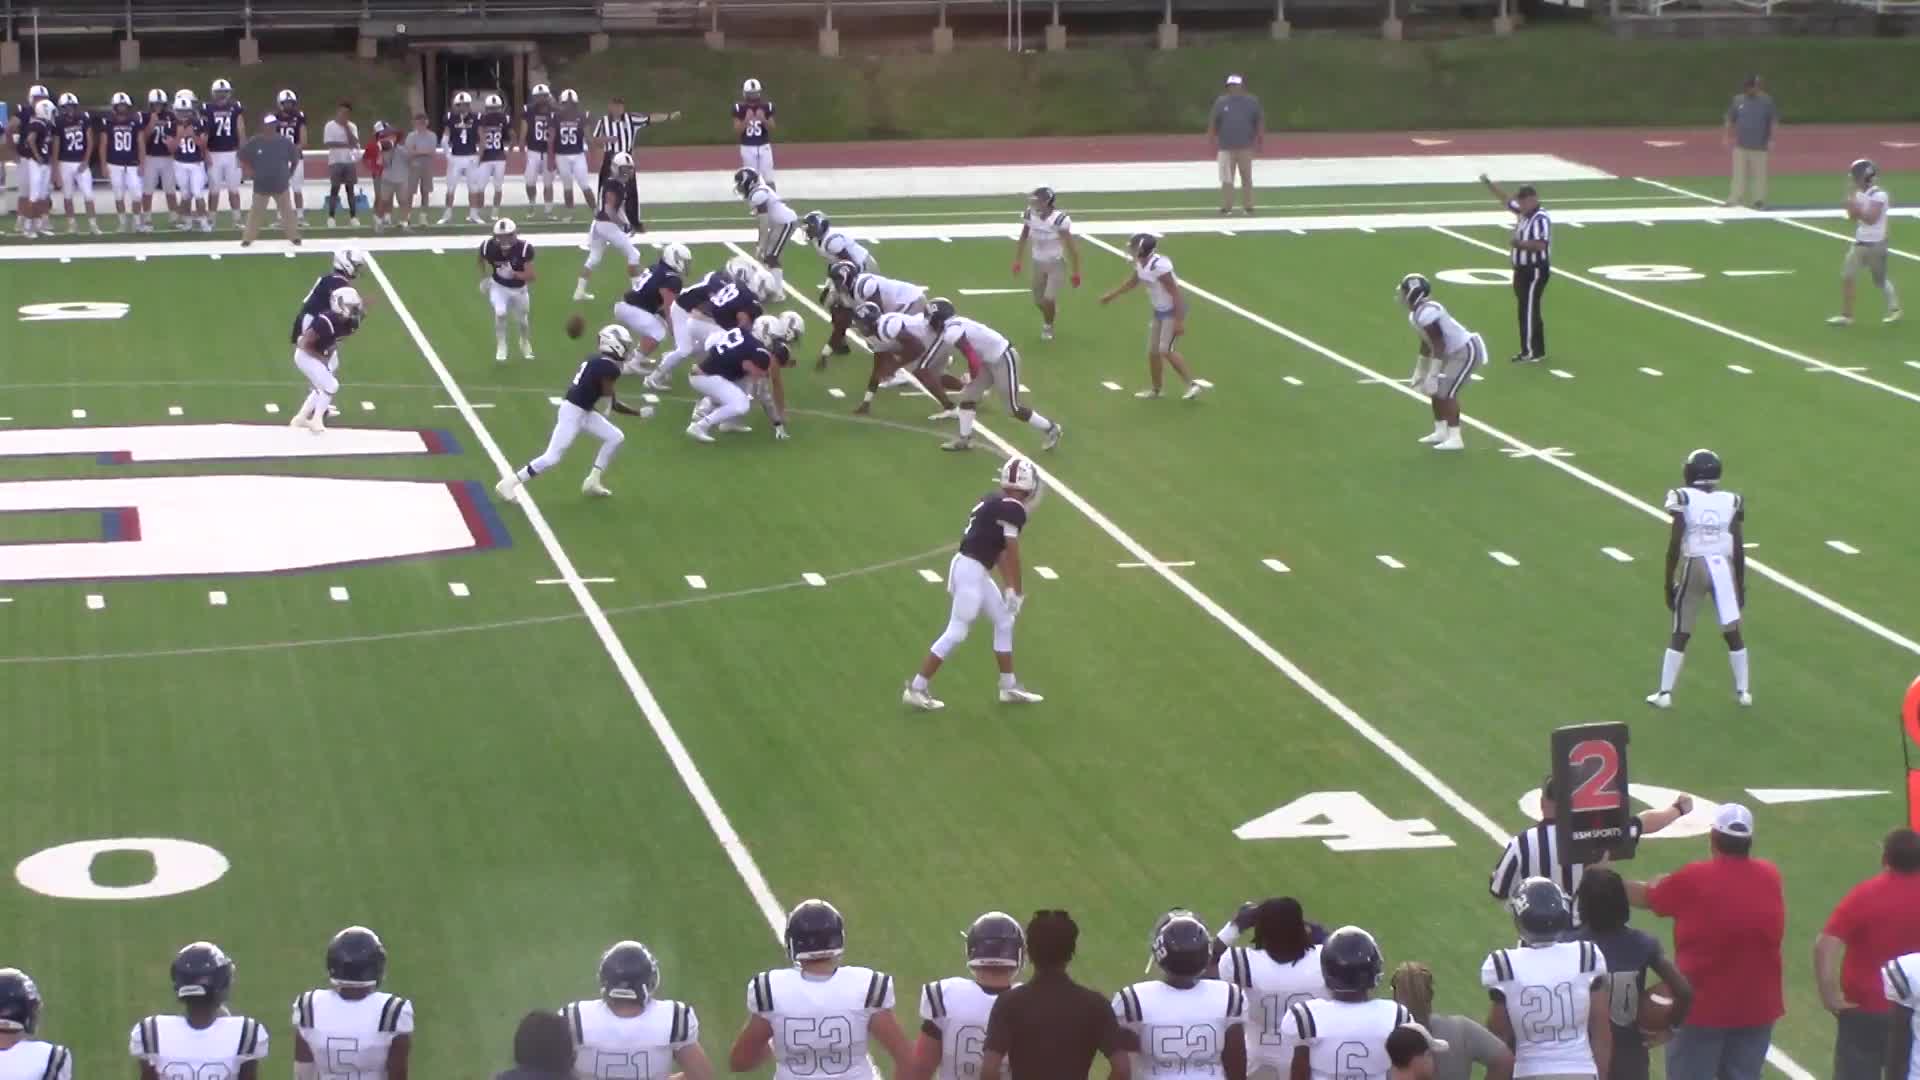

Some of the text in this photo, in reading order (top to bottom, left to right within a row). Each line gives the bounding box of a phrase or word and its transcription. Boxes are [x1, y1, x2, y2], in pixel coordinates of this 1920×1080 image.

[65, 131, 84, 151] 72
[113, 131, 133, 152] 60
[214, 117, 232, 137] 74
[559, 127, 578, 145] 55
[1567, 739, 1619, 813] 2
[1233, 790, 1455, 850] 4
[13, 837, 232, 900] 0
[1520, 981, 1578, 1043] 21
[326, 1036, 361, 1080] 5
[783, 1015, 853, 1077] 53
[1151, 1023, 1217, 1076] 52
[1335, 1040, 1369, 1080] 6
